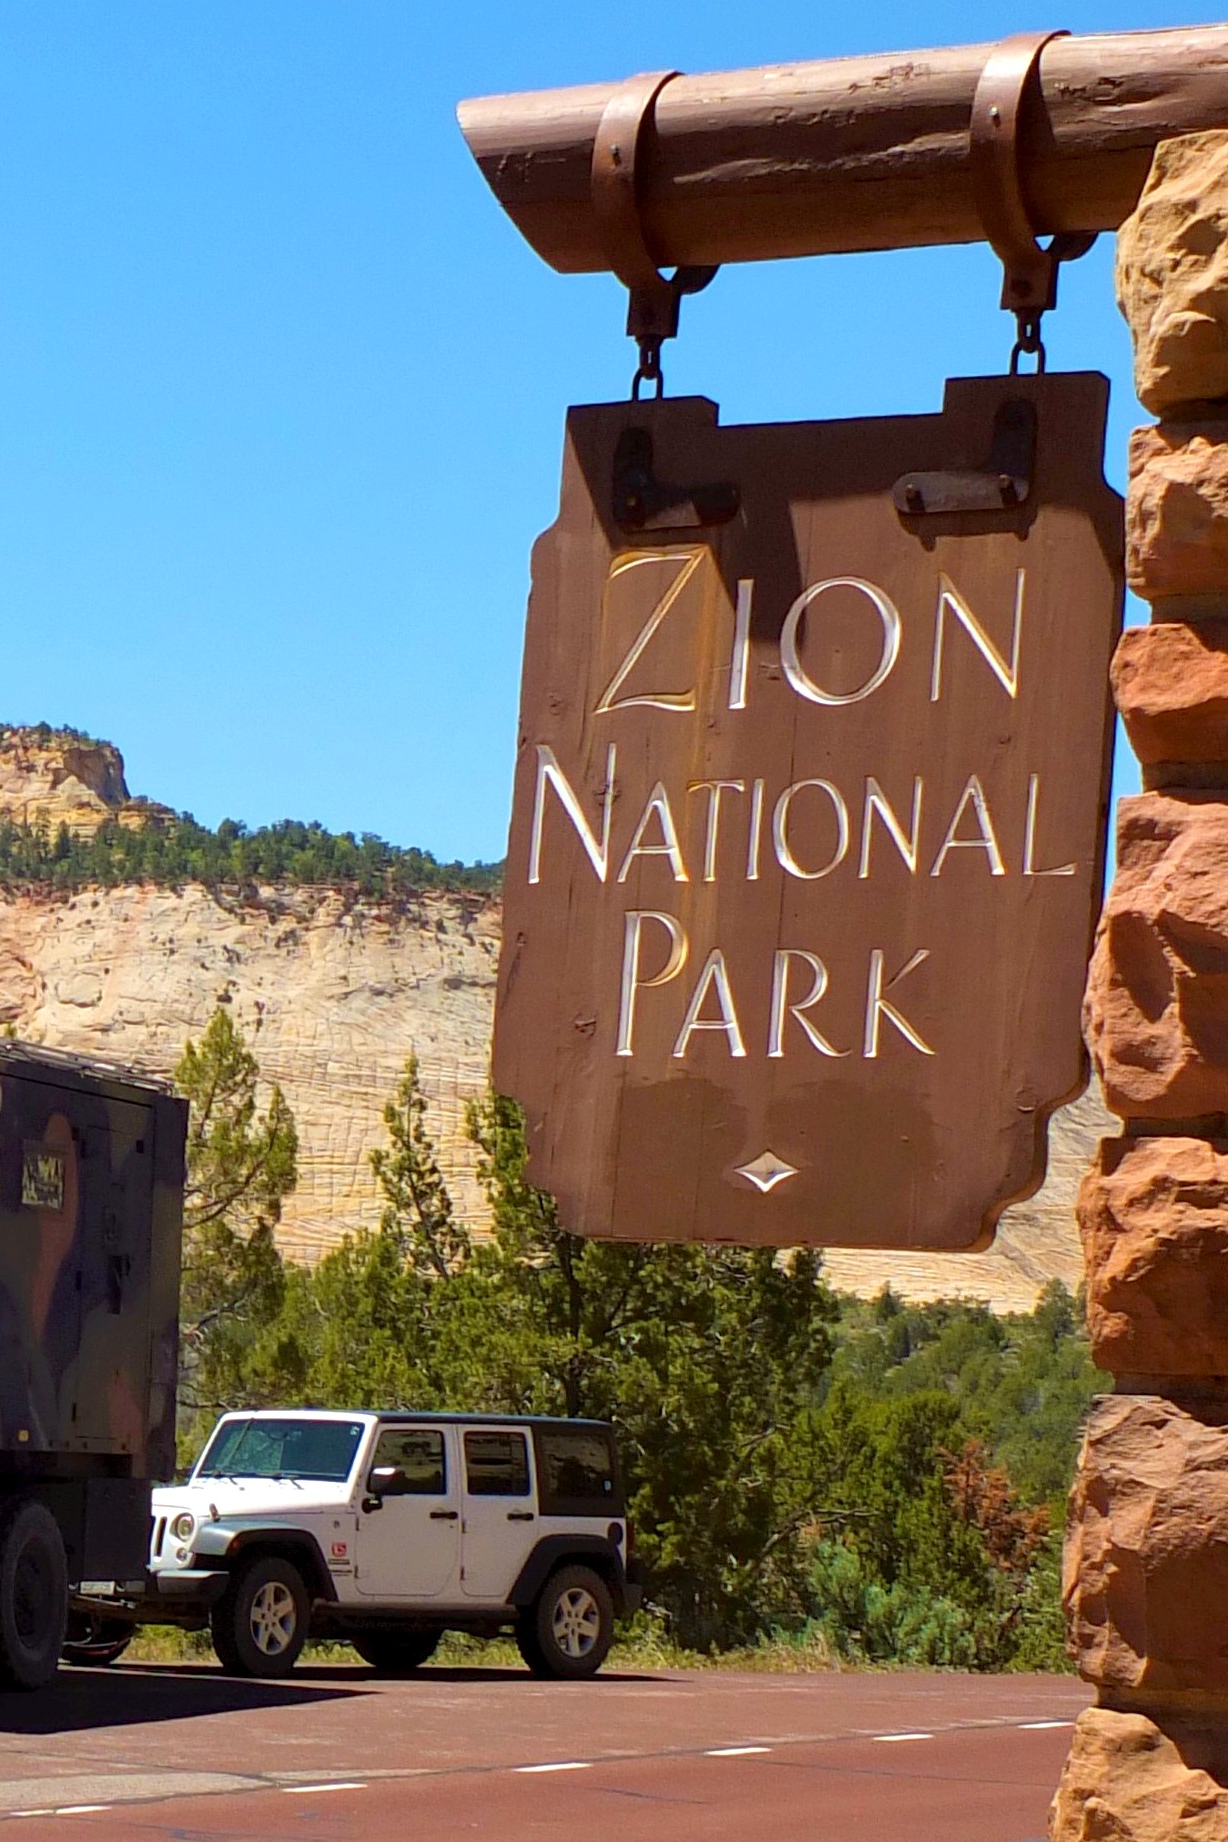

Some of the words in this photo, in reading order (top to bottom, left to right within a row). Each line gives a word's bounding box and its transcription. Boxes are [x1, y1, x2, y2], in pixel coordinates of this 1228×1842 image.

[593, 544, 1026, 713] ZION
[528, 743, 1075, 884] NATIONAL
[616, 910, 935, 1058] PARK
